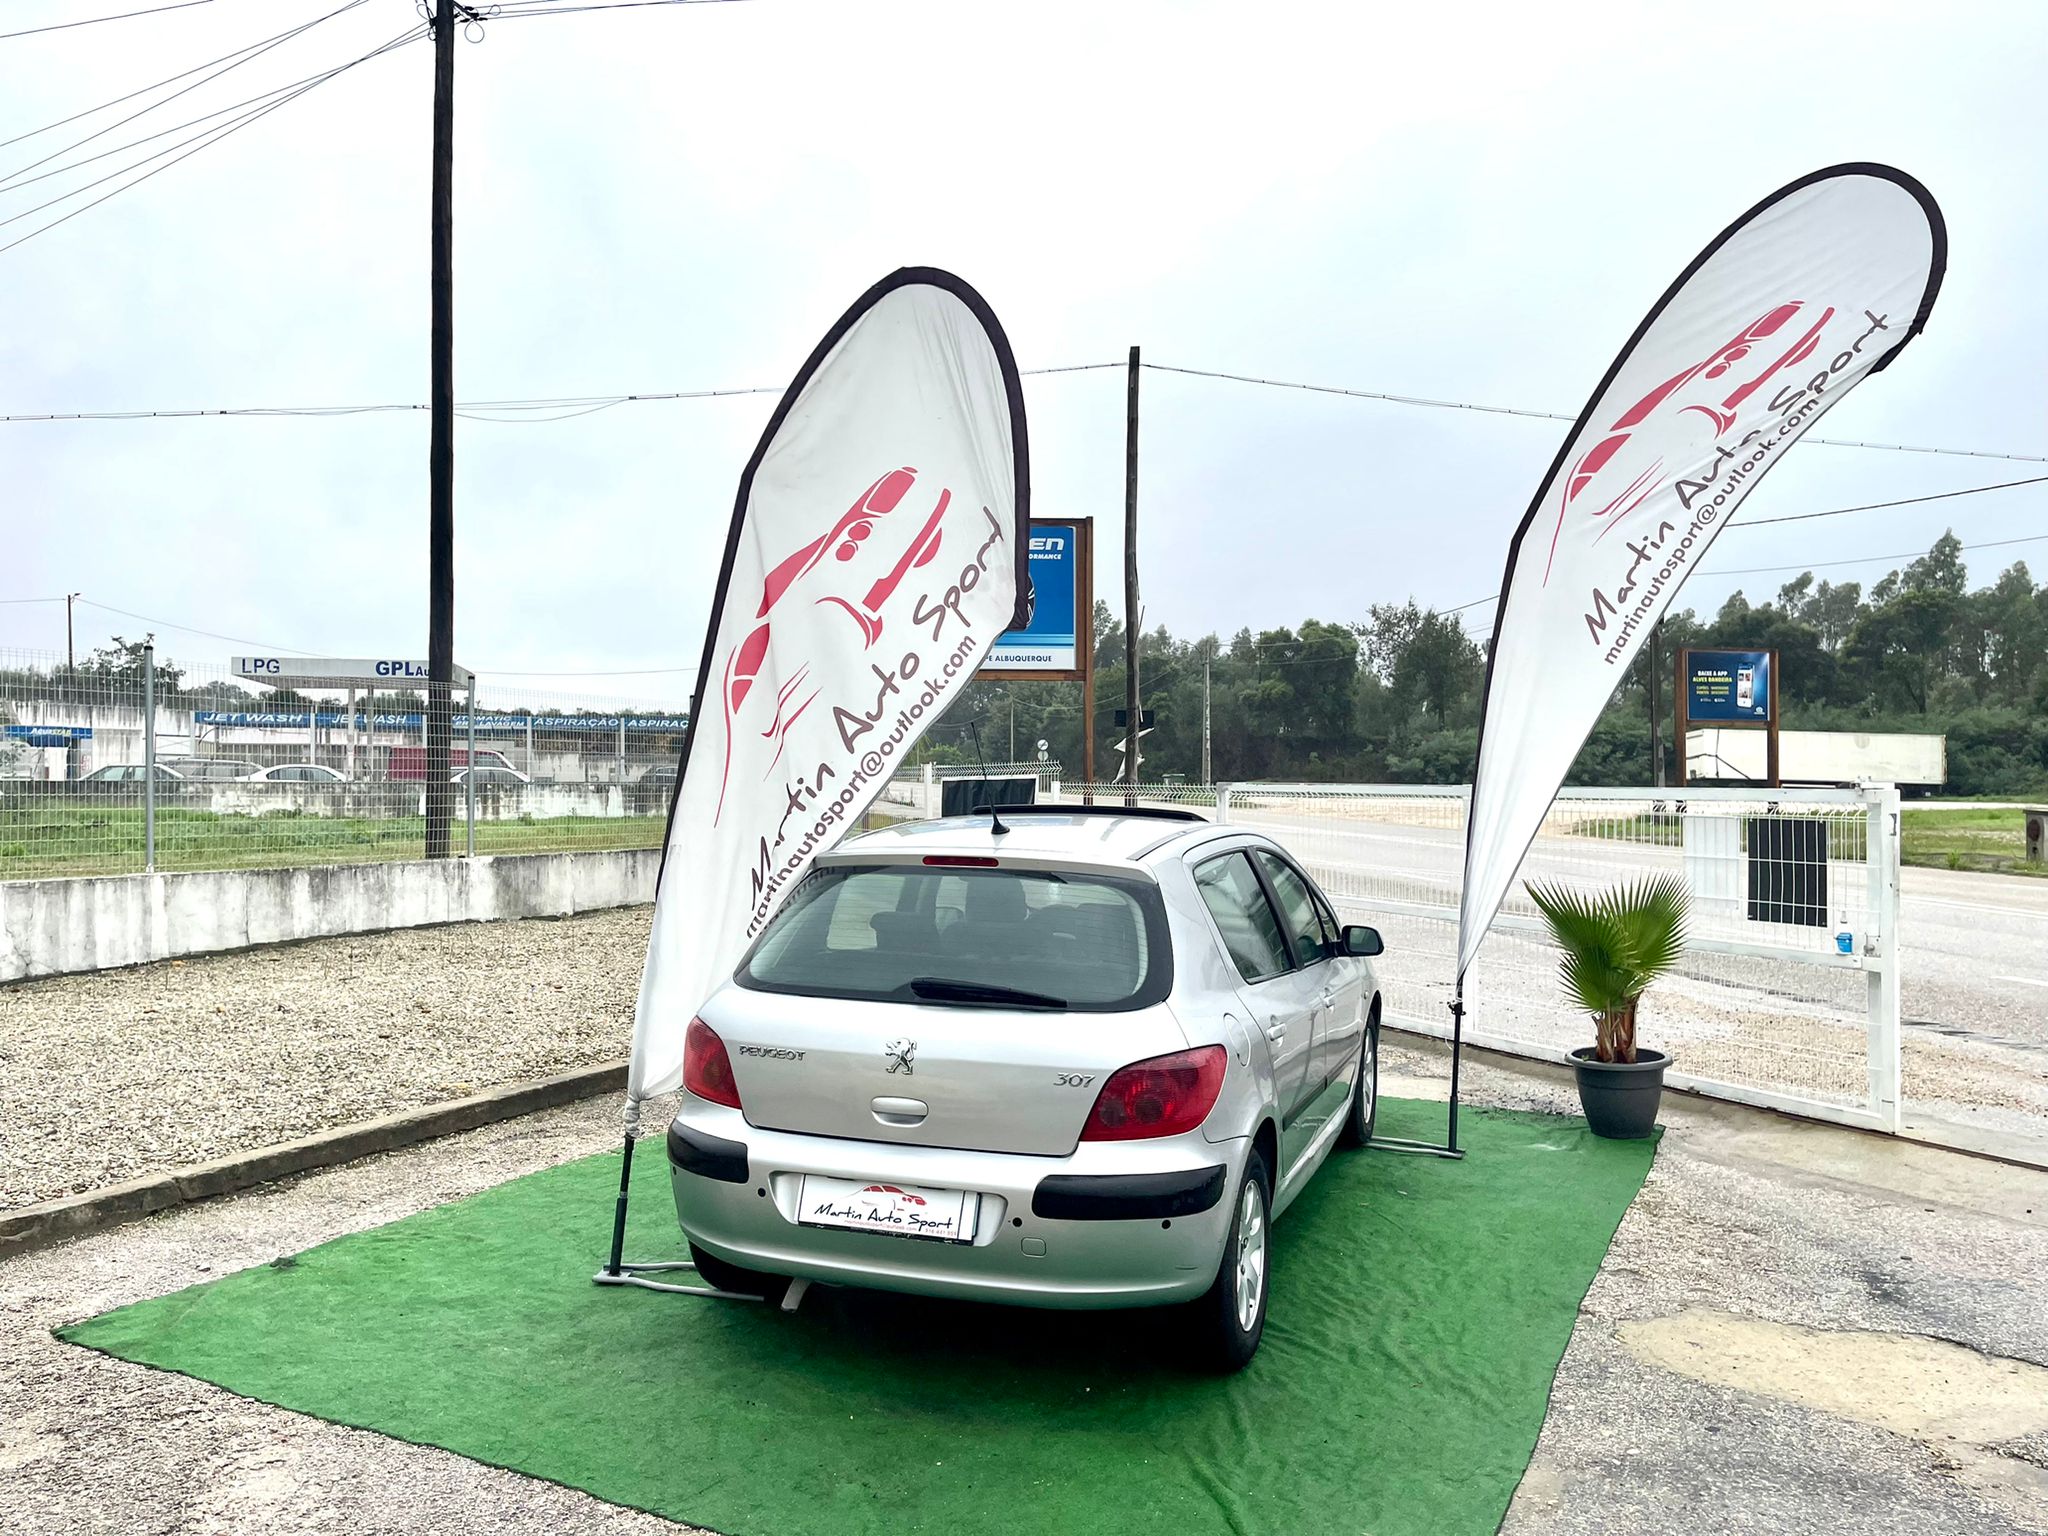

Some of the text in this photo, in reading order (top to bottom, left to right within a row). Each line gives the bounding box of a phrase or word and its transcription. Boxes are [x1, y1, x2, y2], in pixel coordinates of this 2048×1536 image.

[1584, 521, 1675, 645] Martin
[1767, 309, 1889, 416] Sport
[1604, 398, 1820, 665] martinautosport@outlook.com
[832, 651, 920, 754] Auto
[912, 506, 1004, 643] Sport
[241, 658, 280, 674] LPG
[203, 712, 303, 722] JET WASH
[533, 717, 619, 728] ASPIRAÇÃO
[627, 719, 690, 729] ASPIRAÇ
[746, 635, 977, 939] martinautosport@outlook.com
[739, 1044, 806, 1061] PEUGEOT
[1053, 1072, 1096, 1088] 307
[814, 1203, 953, 1231] Martin Auto Sport
